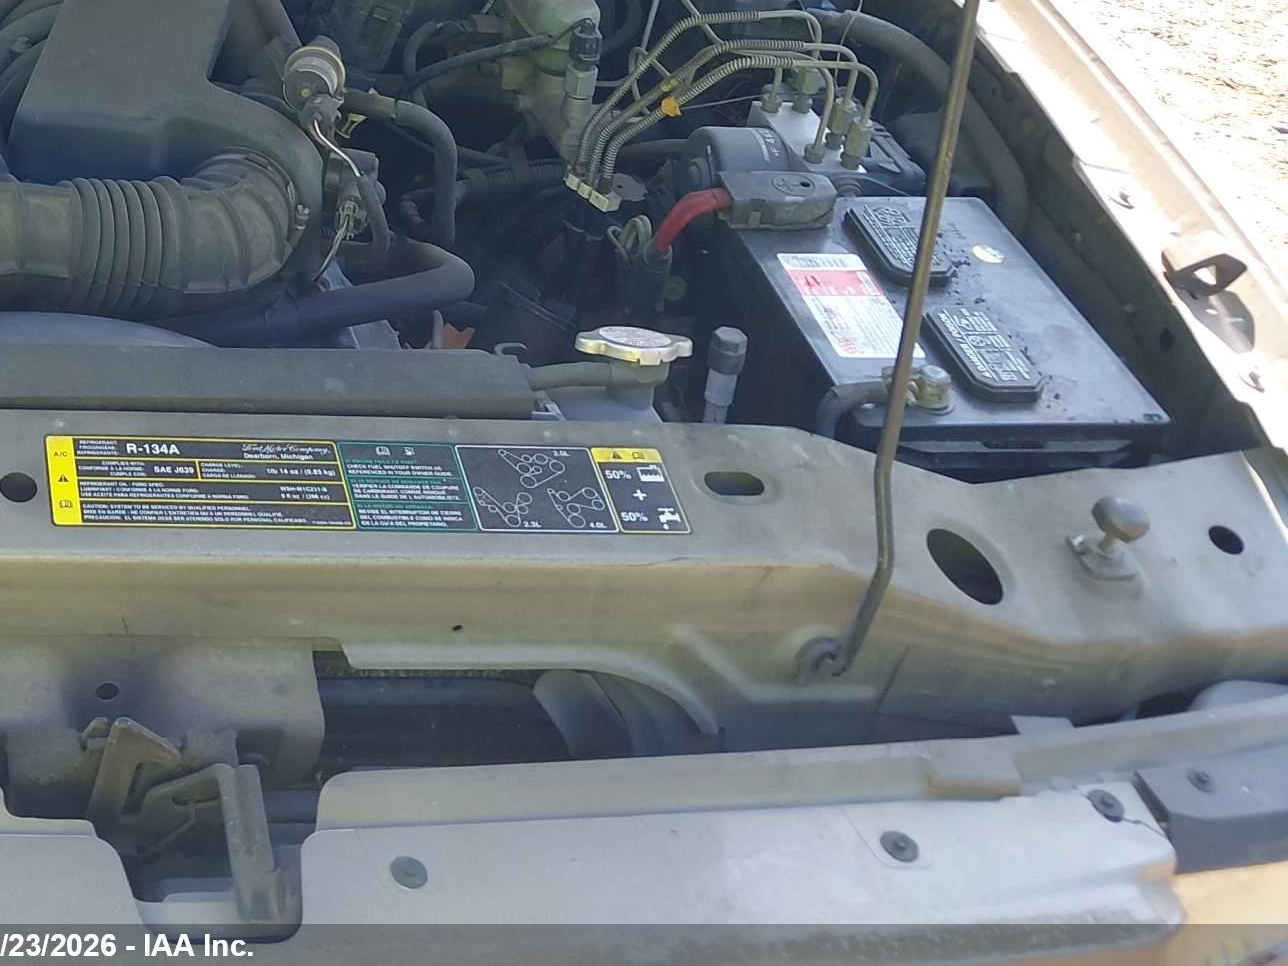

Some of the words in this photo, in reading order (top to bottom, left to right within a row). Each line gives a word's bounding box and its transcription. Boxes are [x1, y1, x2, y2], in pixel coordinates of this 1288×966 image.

[126, 442, 180, 455] R-134A
[174, 466, 195, 474] J639
[604, 470, 632, 480] 50%
[620, 512, 649, 522] 50%
